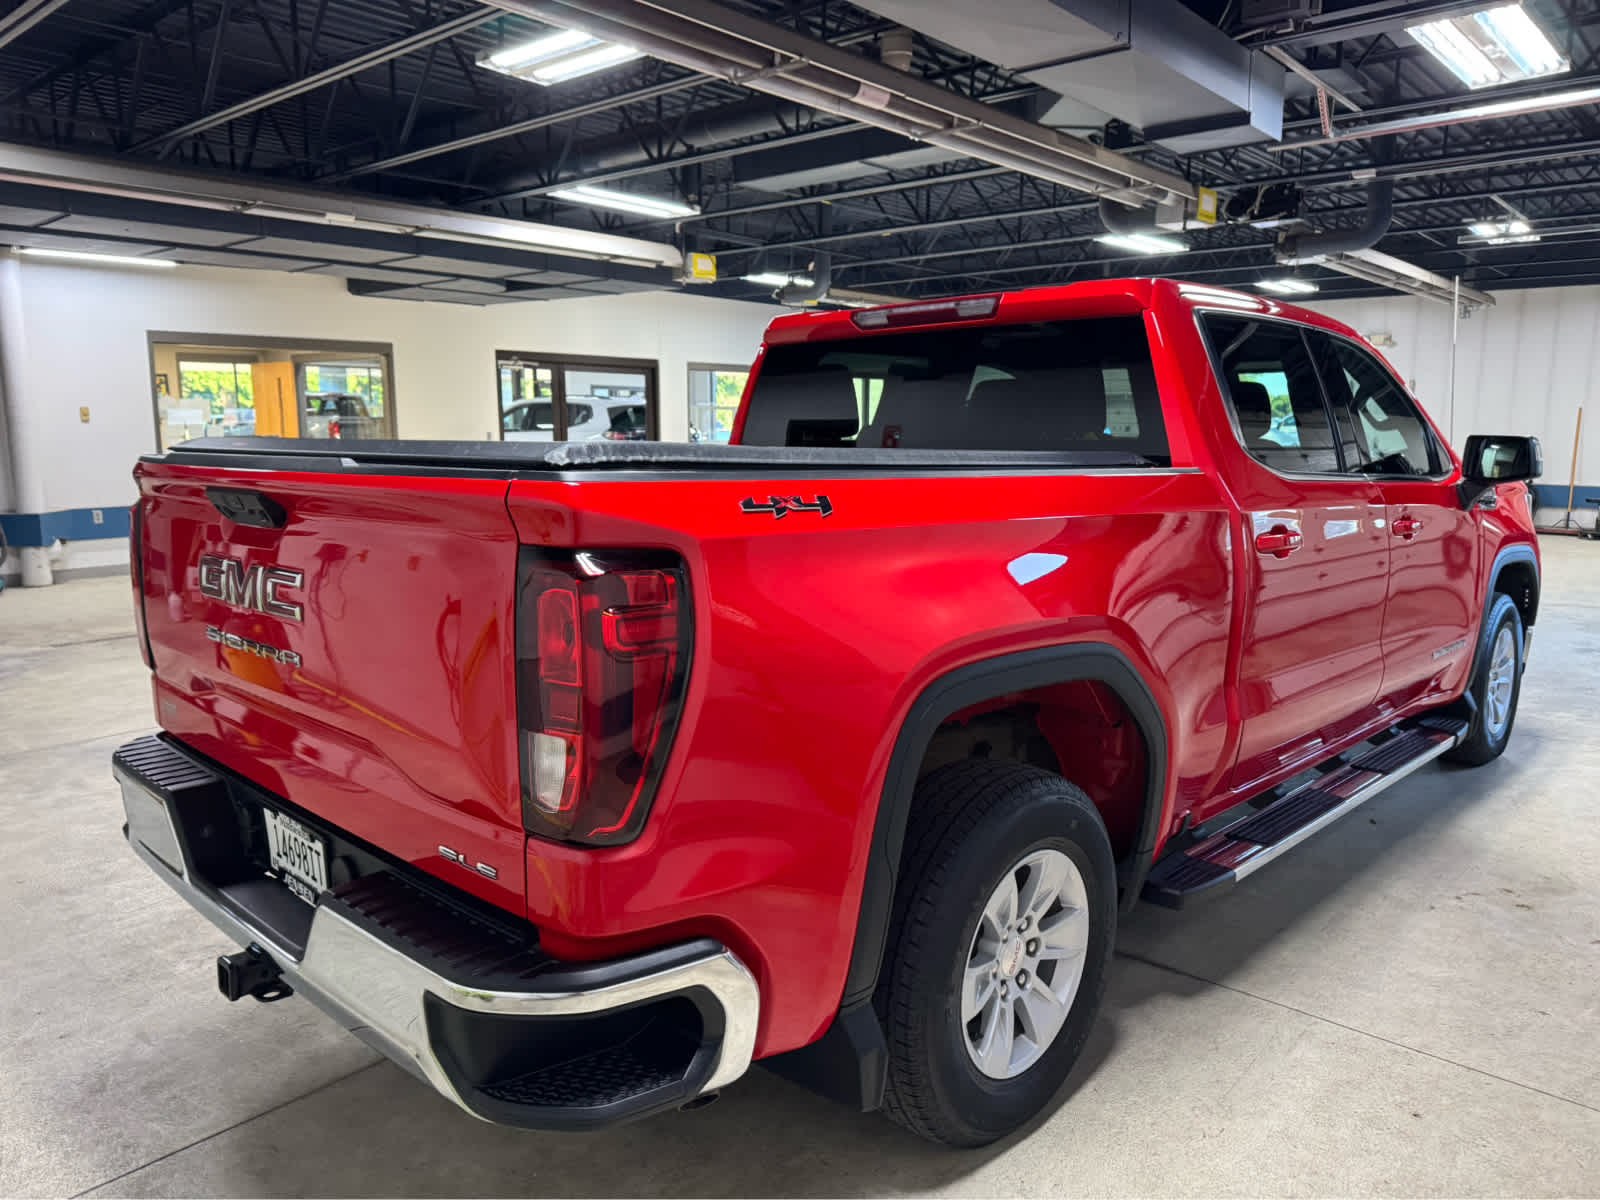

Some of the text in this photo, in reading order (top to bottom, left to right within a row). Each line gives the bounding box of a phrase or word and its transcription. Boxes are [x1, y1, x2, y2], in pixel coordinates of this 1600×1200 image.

[200, 555, 304, 621] GMC
[206, 625, 303, 668] SIERRA
[438, 845, 498, 880] SLE
